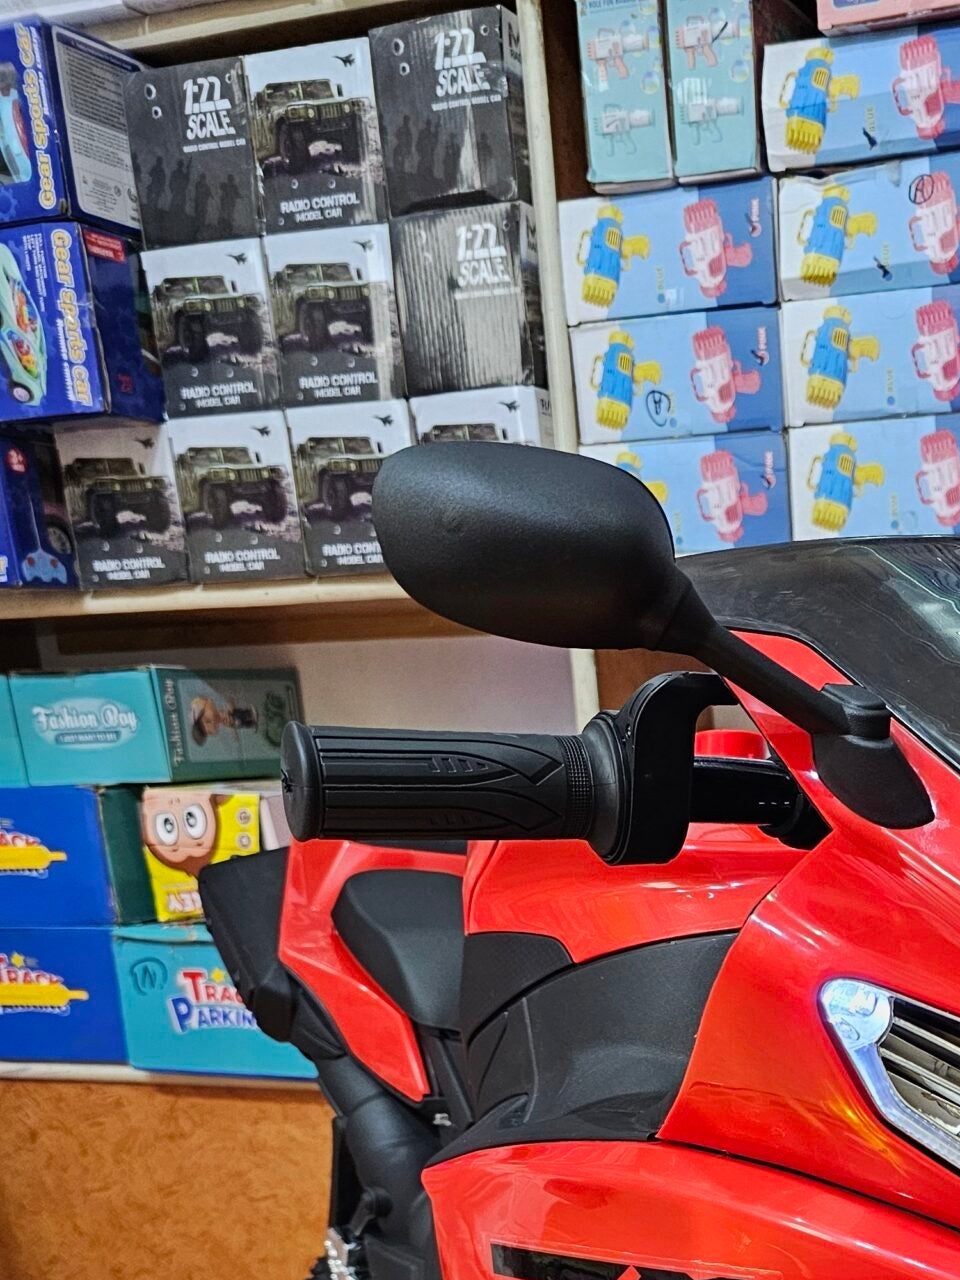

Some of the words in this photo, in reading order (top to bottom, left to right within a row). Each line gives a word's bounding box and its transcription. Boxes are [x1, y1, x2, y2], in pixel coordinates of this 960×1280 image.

[14, 22, 35, 68] car
[434, 28, 486, 70] 1:22
[184, 76, 232, 115] 1:22
[436, 65, 490, 97] SCALE
[23, 69, 50, 150] sports
[187, 111, 236, 140] SCALE
[36, 151, 56, 210] Gear
[280, 196, 311, 214] RADIO
[312, 192, 360, 211] CONTROL
[296, 210, 323, 222] MODEL
[324, 207, 343, 220] CAR
[51, 228, 75, 288] Gear
[457, 222, 507, 261] 1:22
[457, 258, 511, 288] SCALE
[57, 288, 87, 364] sports
[71, 365, 93, 406] car
[180, 385, 210, 399] RADIO
[212, 382, 257, 397] CONTROL
[299, 375, 330, 389] RADIO
[332, 371, 378, 386] CONTROL
[204, 550, 235, 564] RADIO
[236, 547, 281, 562] CONTROL
[352, 540, 382, 556] CONT
[32, 705, 98, 732] Fashion
[101, 703, 139, 732] Boy
[171, 998, 257, 1033] PARKIN
